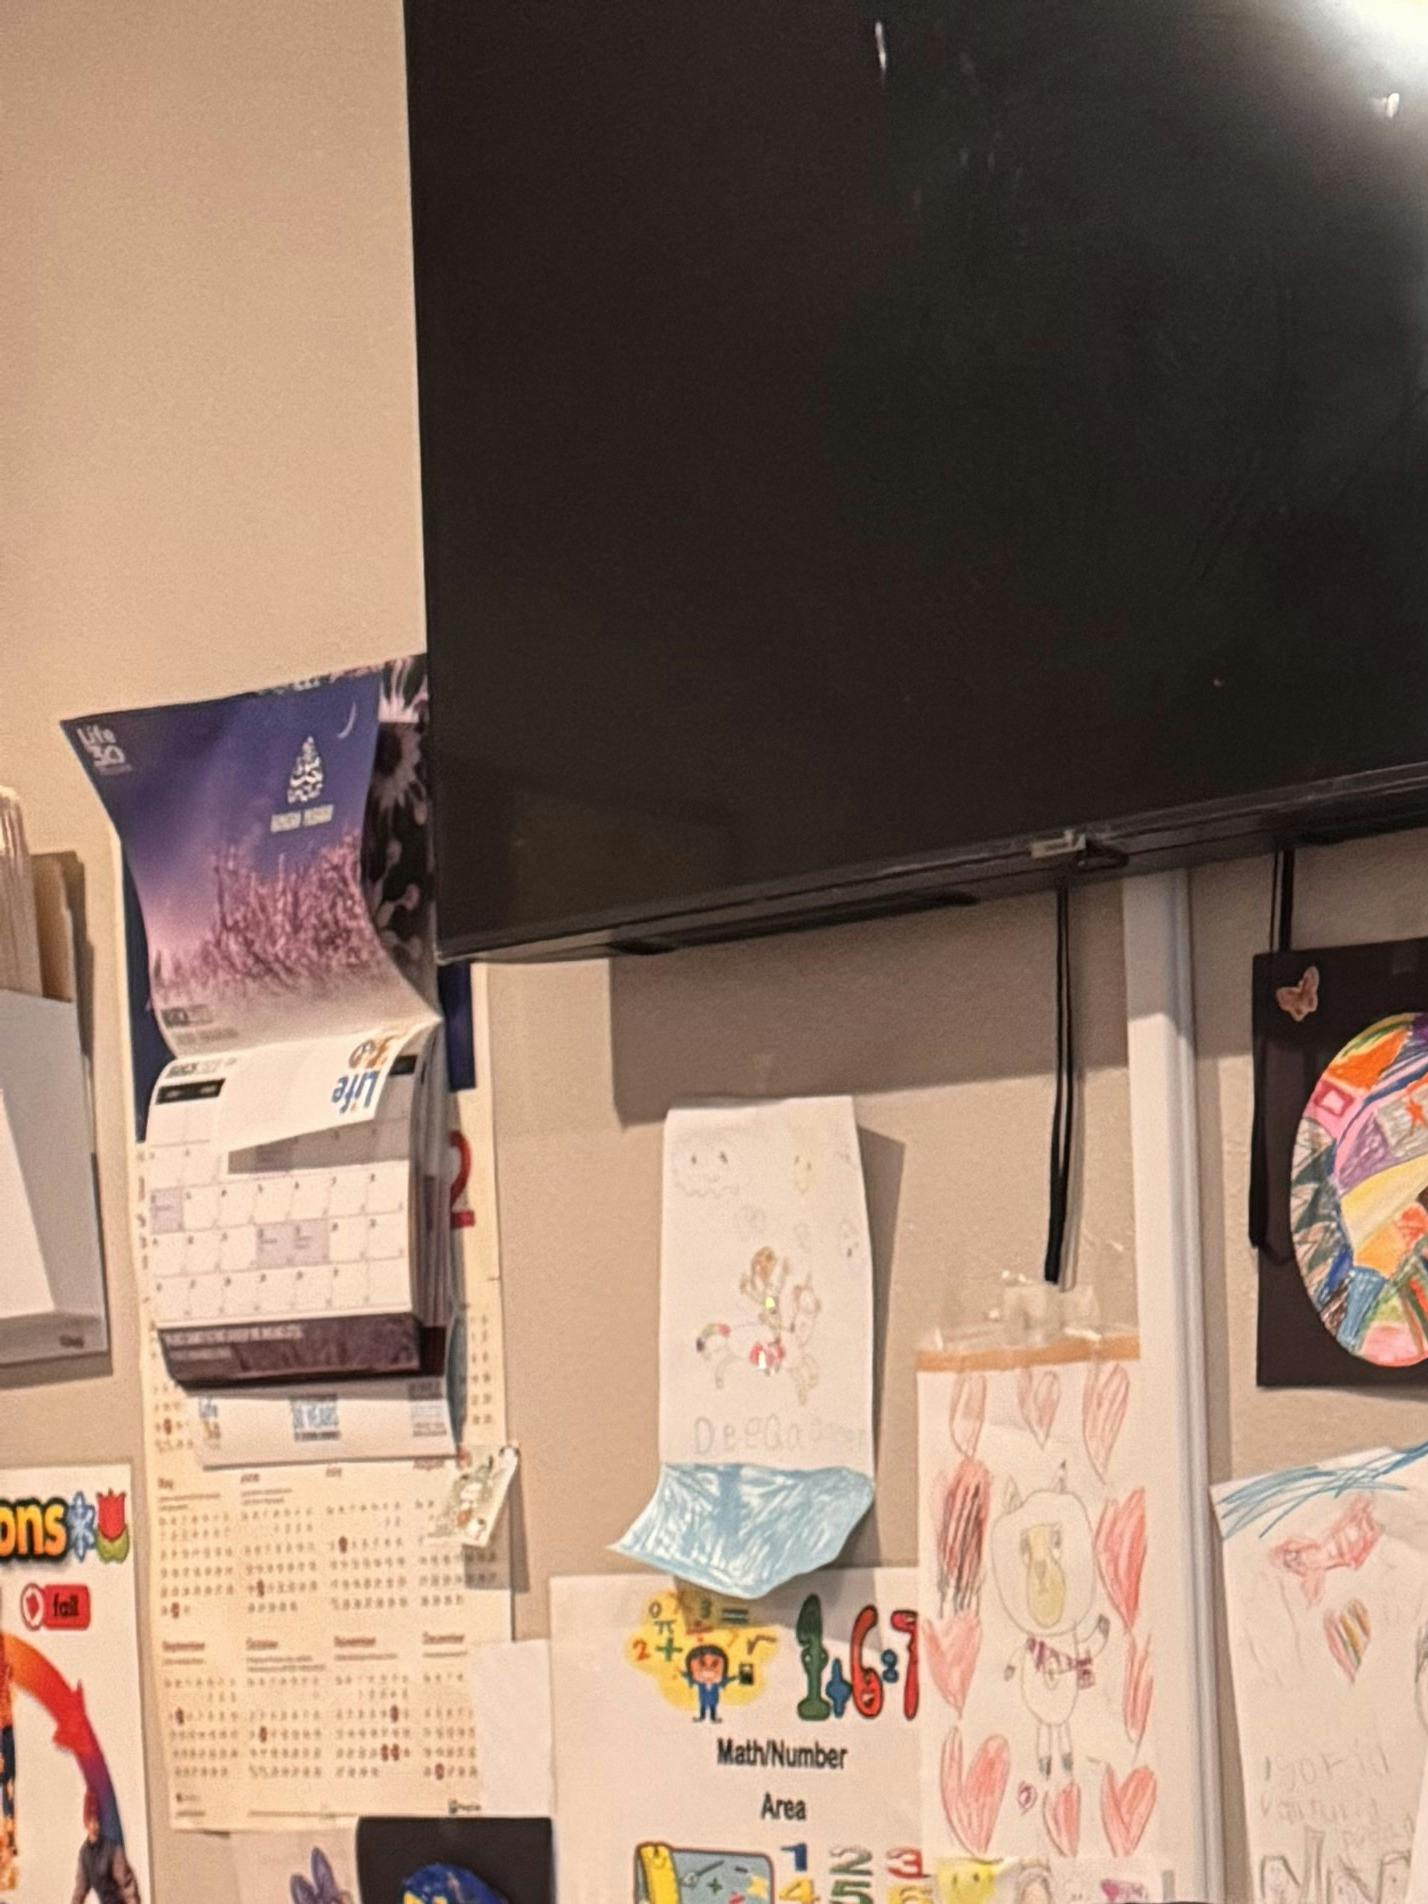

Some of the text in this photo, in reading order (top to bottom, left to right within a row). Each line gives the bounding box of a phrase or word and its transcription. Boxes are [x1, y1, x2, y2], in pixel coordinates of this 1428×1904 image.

[53, 1592, 79, 1617] fall
[716, 1737, 849, 1771] Math/Number
[760, 1791, 808, 1821] Area
[779, 1842, 932, 1880] 1 2 3
